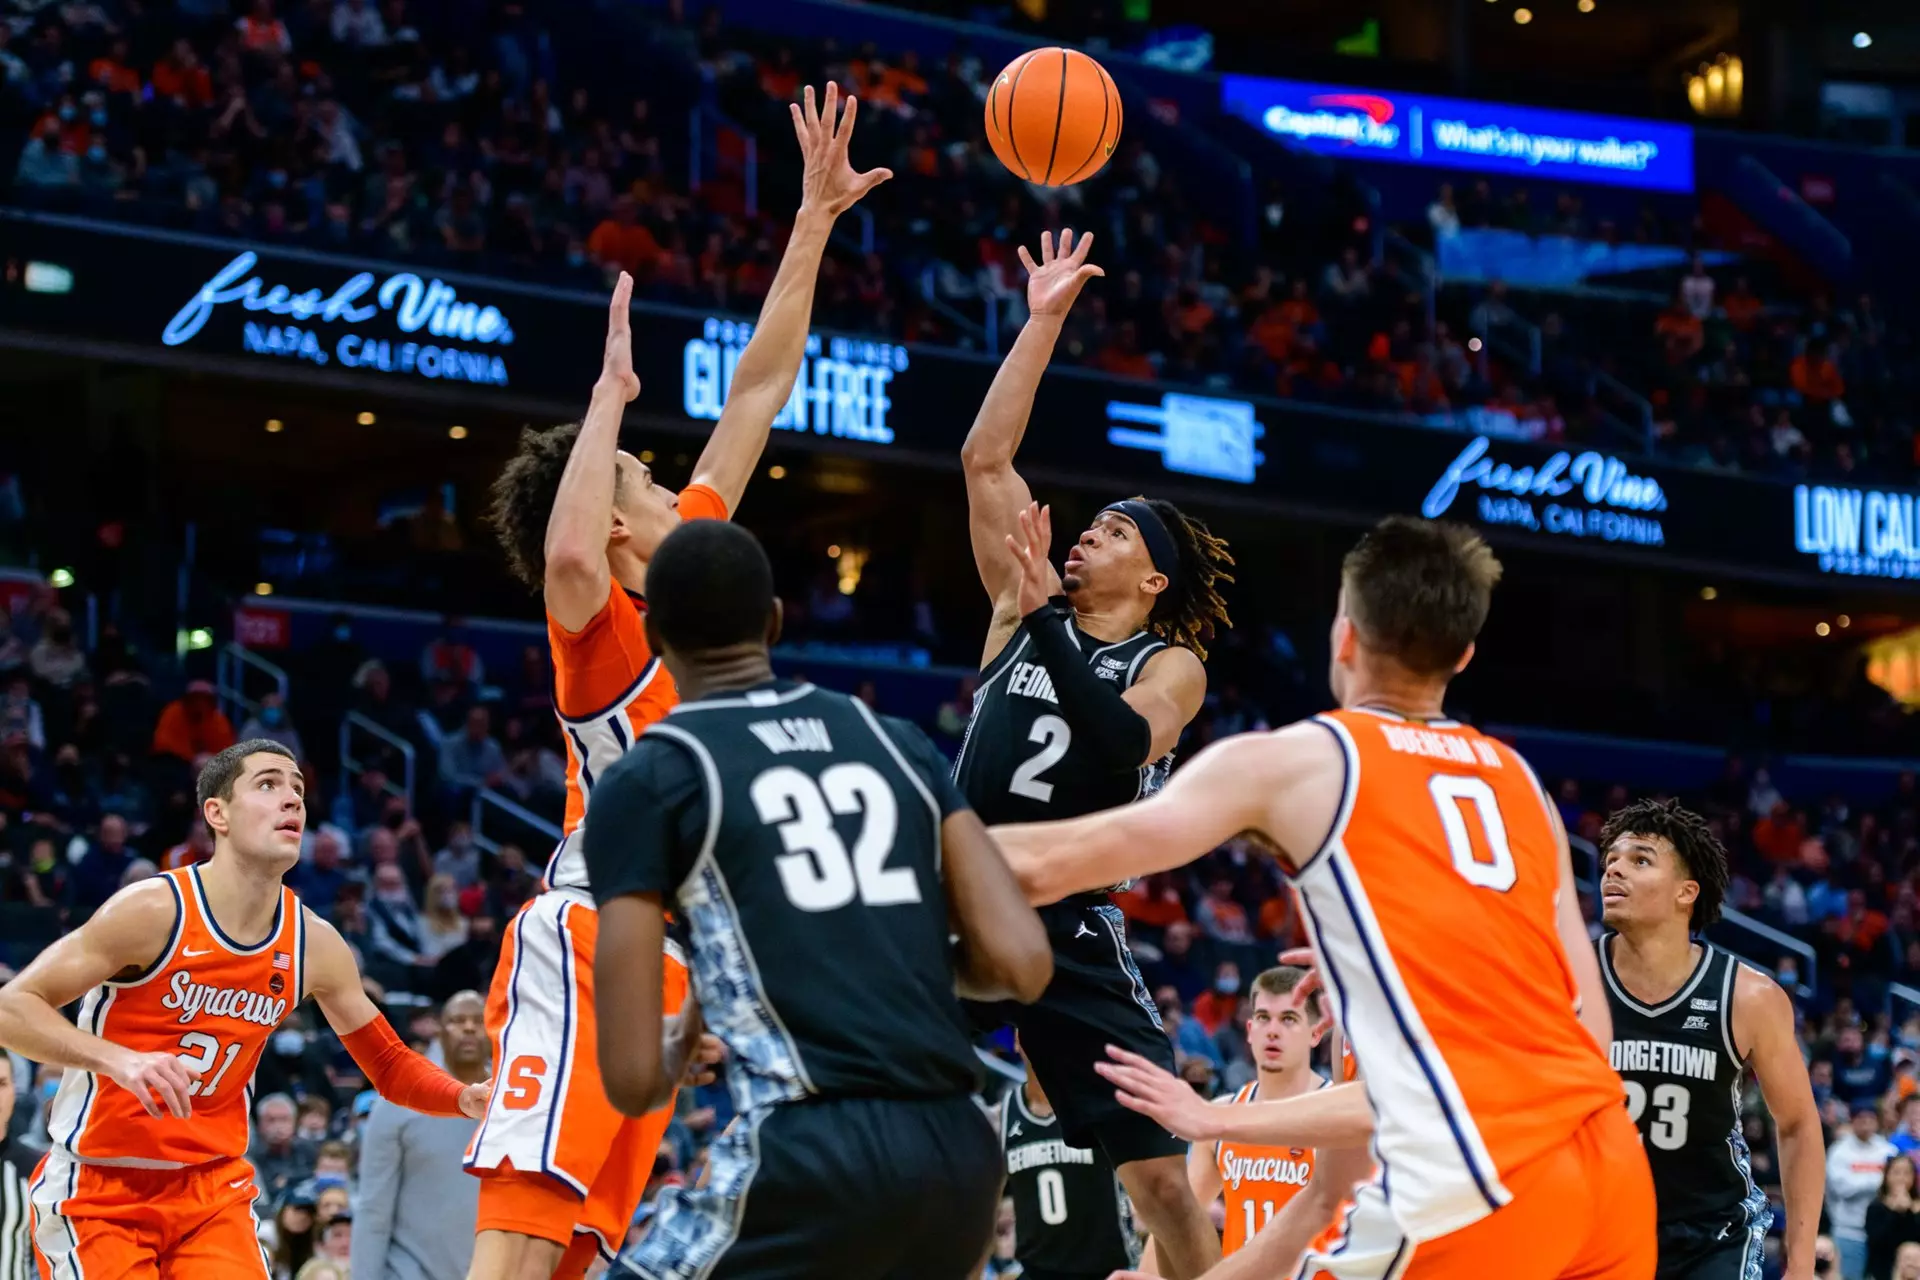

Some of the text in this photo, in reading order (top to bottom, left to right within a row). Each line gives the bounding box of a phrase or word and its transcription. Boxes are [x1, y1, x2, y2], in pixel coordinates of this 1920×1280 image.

[162, 251, 375, 346] fresh
[336, 334, 509, 386] CALIFORNIA
[684, 338, 895, 444] GLN-FREE
[1421, 435, 1574, 519] fresh
[1793, 484, 1920, 562] LOW CAL
[1008, 714, 1072, 804] 2
[749, 761, 923, 913] 32
[1428, 772, 1519, 893] 0
[161, 969, 287, 1028] Syracuse
[174, 1030, 244, 1098] 21
[502, 1055, 548, 1111] S
[1609, 1039, 1718, 1082] ORGETOWN
[1037, 1168, 1067, 1226] 0
[1222, 1149, 1310, 1190] Syracuse
[1242, 1199, 1275, 1247] 11
